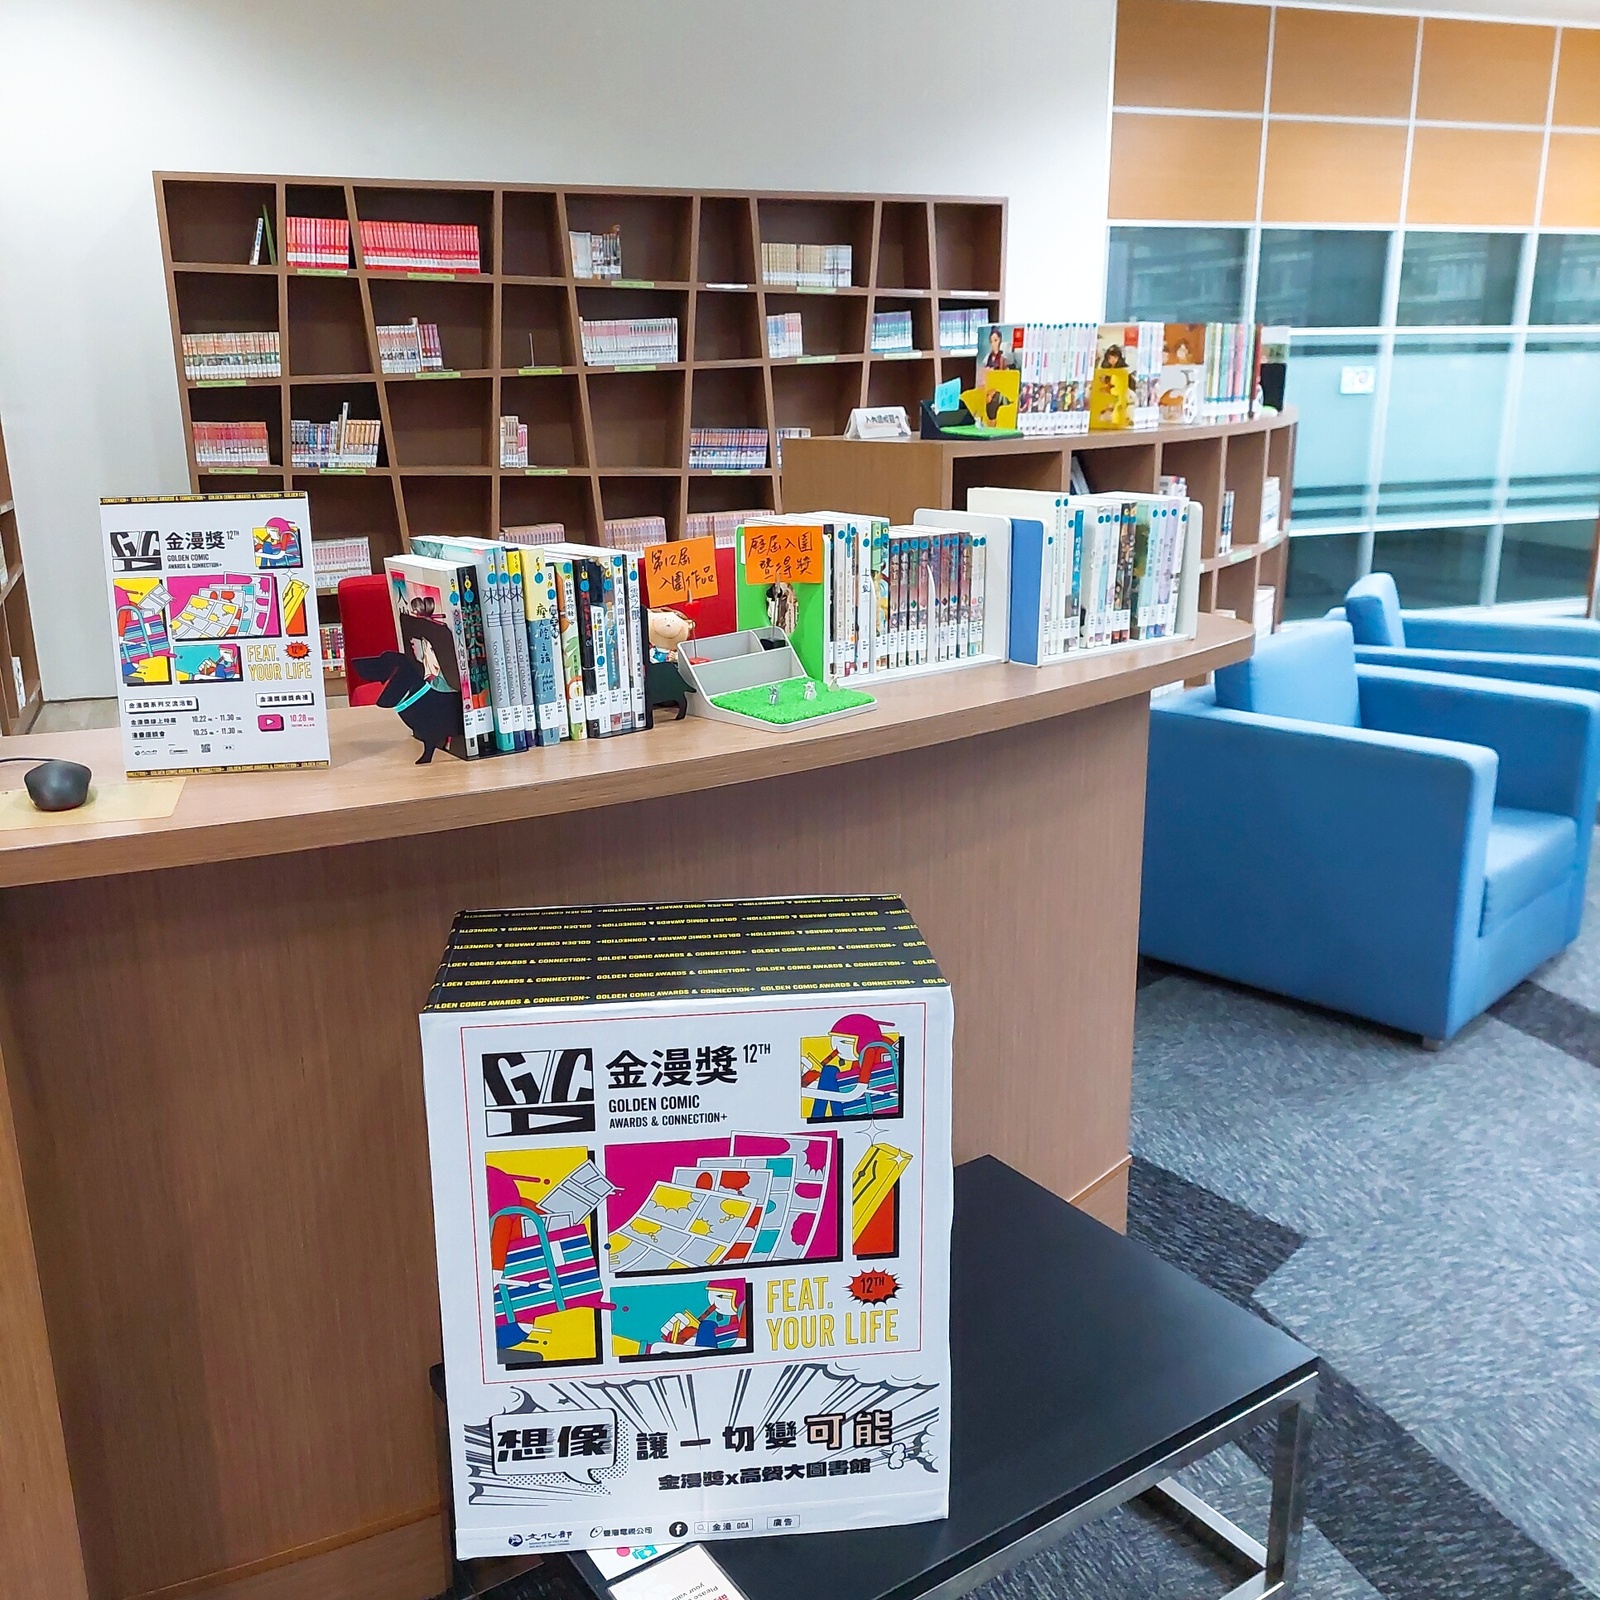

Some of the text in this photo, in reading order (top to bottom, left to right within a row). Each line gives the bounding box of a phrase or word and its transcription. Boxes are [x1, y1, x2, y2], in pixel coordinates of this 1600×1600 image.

[165, 531, 226, 551] 金漫獎
[167, 554, 189, 562] GOLDEN
[651, 547, 691, 574] 第12屆
[659, 566, 714, 591] 入圍作品
[247, 644, 279, 662] FEAT.
[248, 662, 312, 681] YOUR LIFE
[192, 715, 206, 723] 10.22
[742, 1043, 771, 1064] 12TH
[605, 1045, 739, 1090] 金漫獎
[608, 1094, 700, 1113] GOLDEN COMIC
[609, 1112, 728, 1129] AWARDS & CONNECTION+
[860, 1276, 885, 1294] 12TH
[767, 1277, 833, 1313] FEAT.
[766, 1309, 899, 1351] YOUR LIFE
[497, 1423, 613, 1462] 想像
[712, 1522, 732, 1531] 金漫
[773, 1517, 793, 1527] 廣告
[525, 1530, 574, 1541] 文化部
[603, 1526, 653, 1537] 臺灣電視公司
[689, 1582, 705, 1594] your
